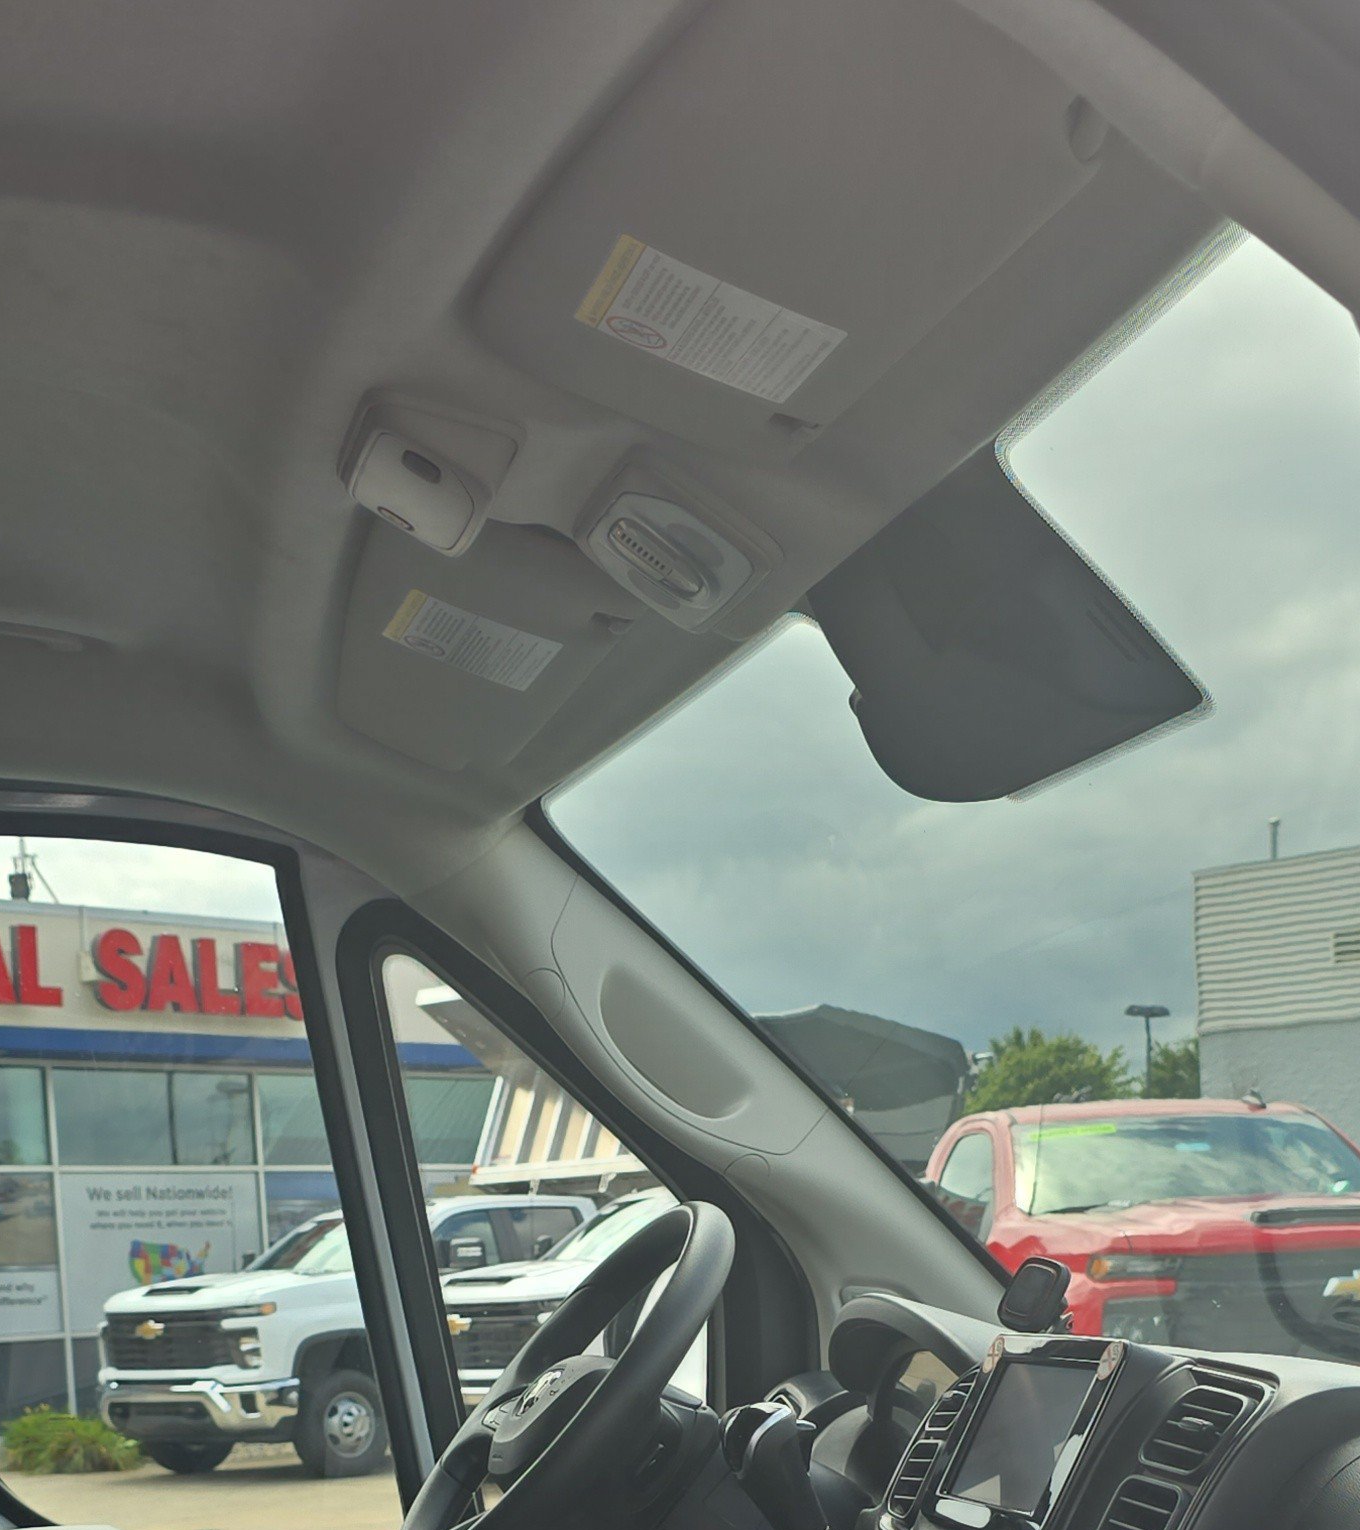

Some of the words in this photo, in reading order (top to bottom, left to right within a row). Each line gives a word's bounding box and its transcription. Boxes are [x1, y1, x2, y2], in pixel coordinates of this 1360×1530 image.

[86, 1186, 111, 1200] We
[116, 1185, 141, 1200] sell
[146, 1184, 233, 1200] Nationwide!
